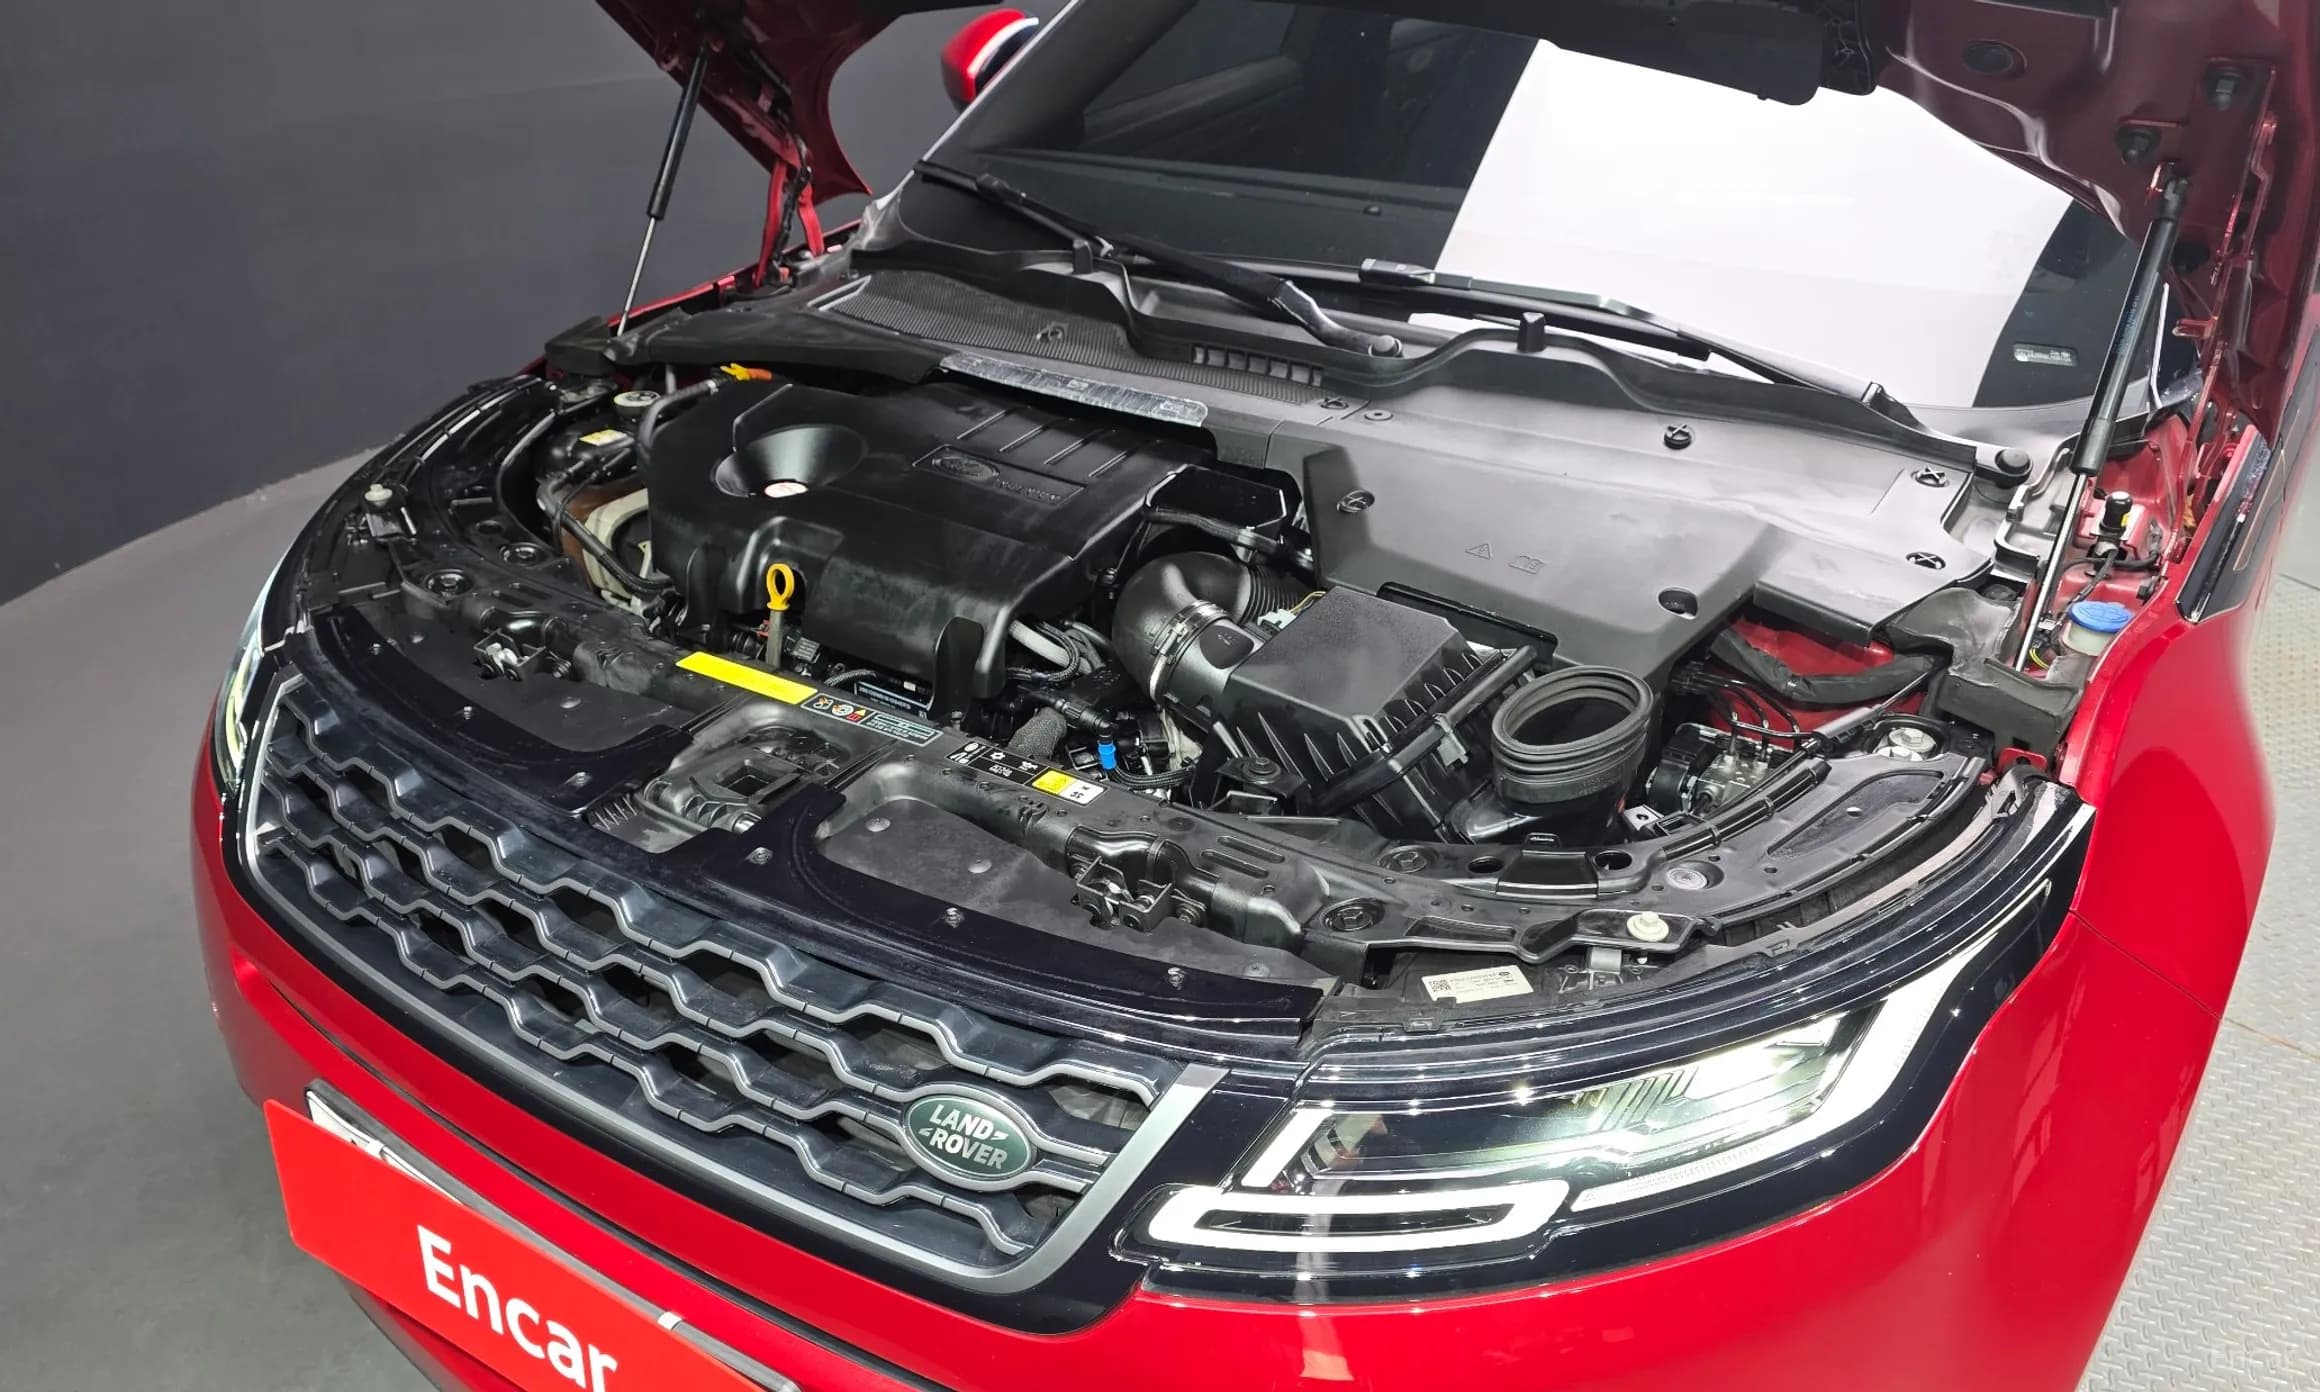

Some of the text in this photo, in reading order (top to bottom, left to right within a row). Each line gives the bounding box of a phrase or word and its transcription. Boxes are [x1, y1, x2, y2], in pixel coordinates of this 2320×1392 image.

[929, 1104, 995, 1140] LAND
[929, 1128, 1008, 1169] ROVER
[417, 1224, 618, 1392] Encar
